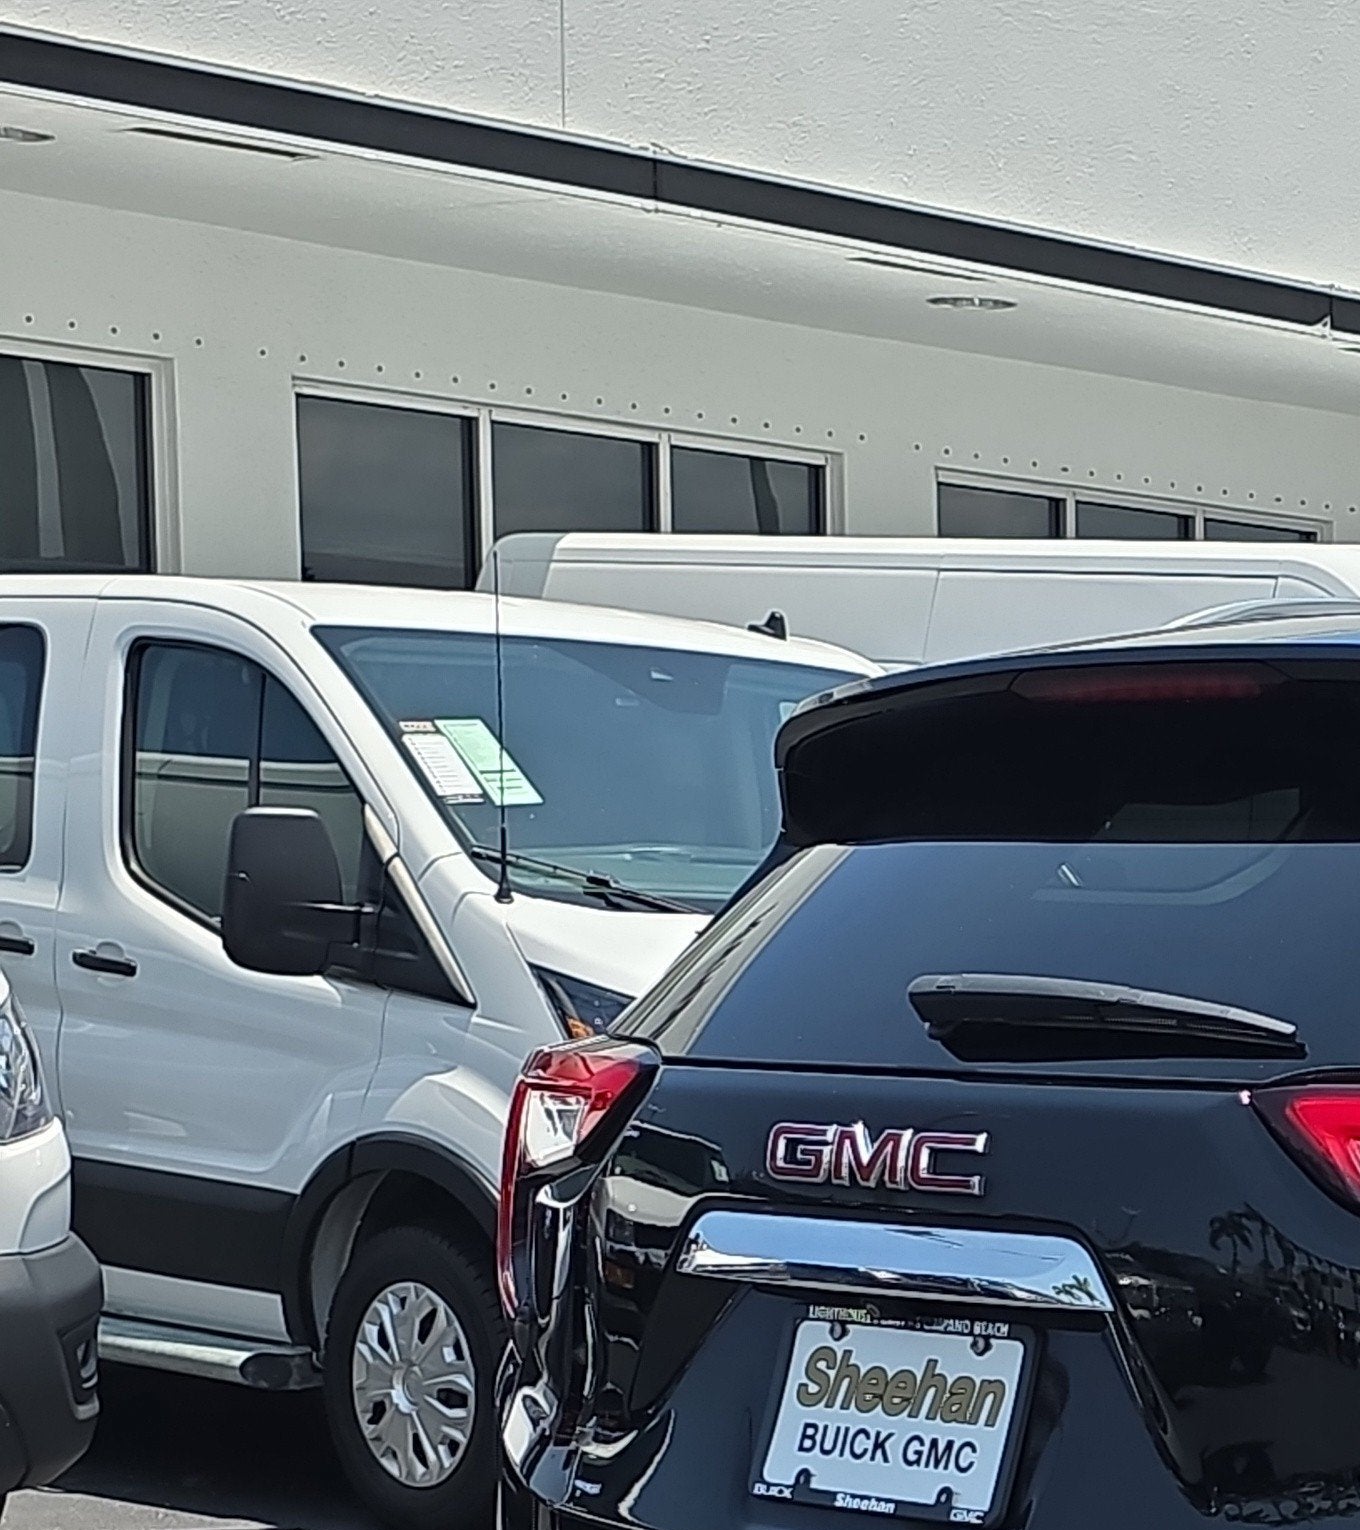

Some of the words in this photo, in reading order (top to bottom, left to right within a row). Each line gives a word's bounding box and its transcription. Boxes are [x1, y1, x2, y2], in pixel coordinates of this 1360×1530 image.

[766, 1120, 989, 1196] GMC
[796, 1345, 1006, 1428] Sheehan
[797, 1422, 895, 1464] BUICK
[901, 1434, 978, 1475] GMC
[752, 1482, 793, 1499] BUICK
[834, 1493, 896, 1514] Sheehan
[950, 1509, 985, 1525] GMC
